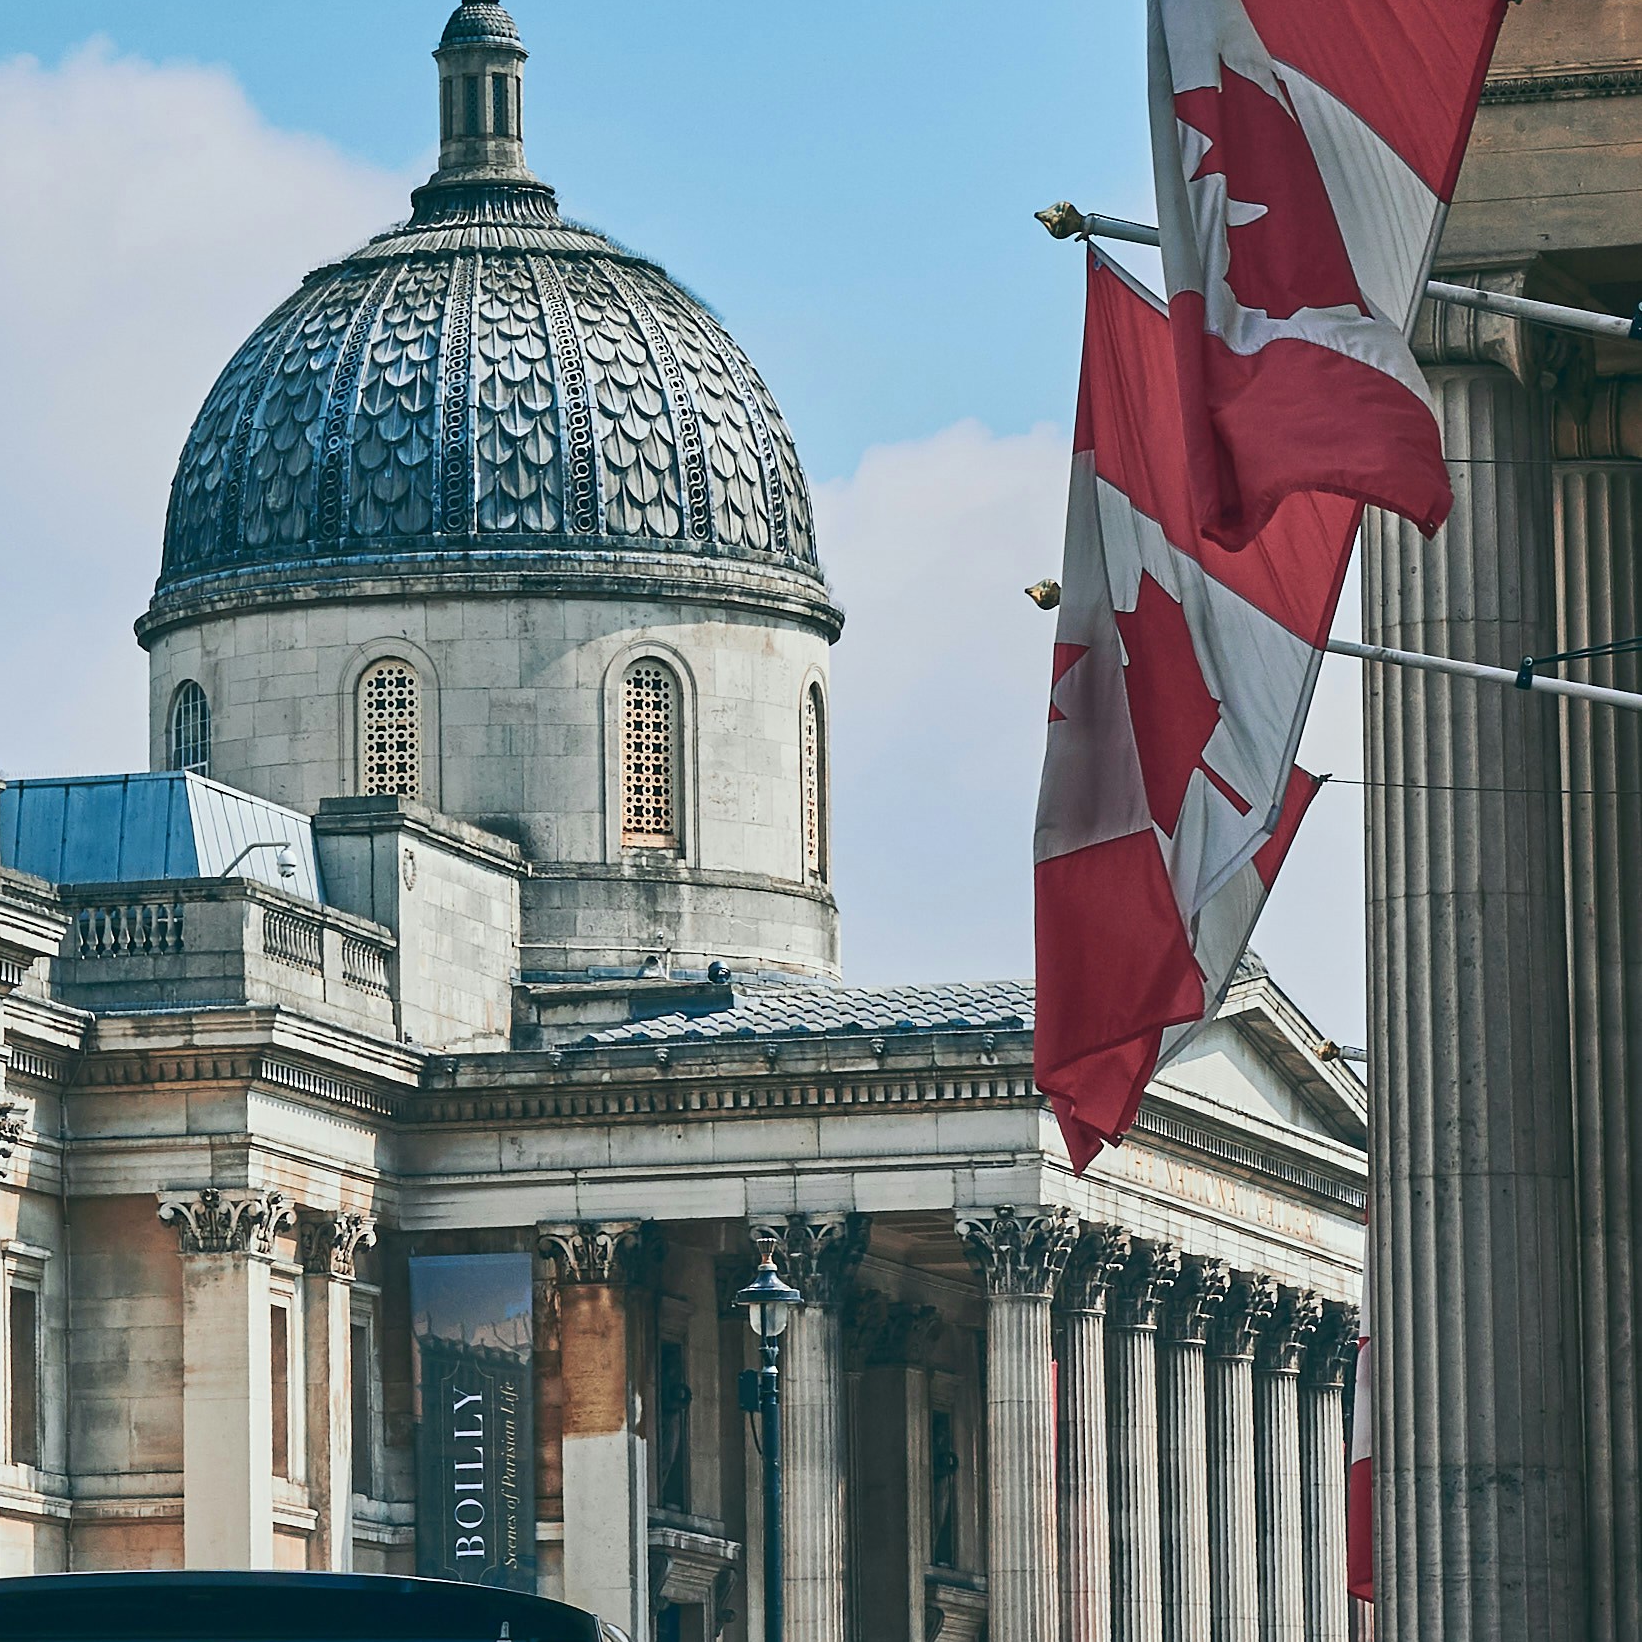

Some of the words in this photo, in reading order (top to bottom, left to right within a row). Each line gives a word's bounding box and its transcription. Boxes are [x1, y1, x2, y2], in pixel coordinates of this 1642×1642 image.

[500, 1381, 519, 1415] Life
[453, 1384, 485, 1560] BOILLY
[501, 1419, 517, 1489] Parisian
[501, 1489, 520, 1509] of
[504, 1513, 518, 1570] Scenes
